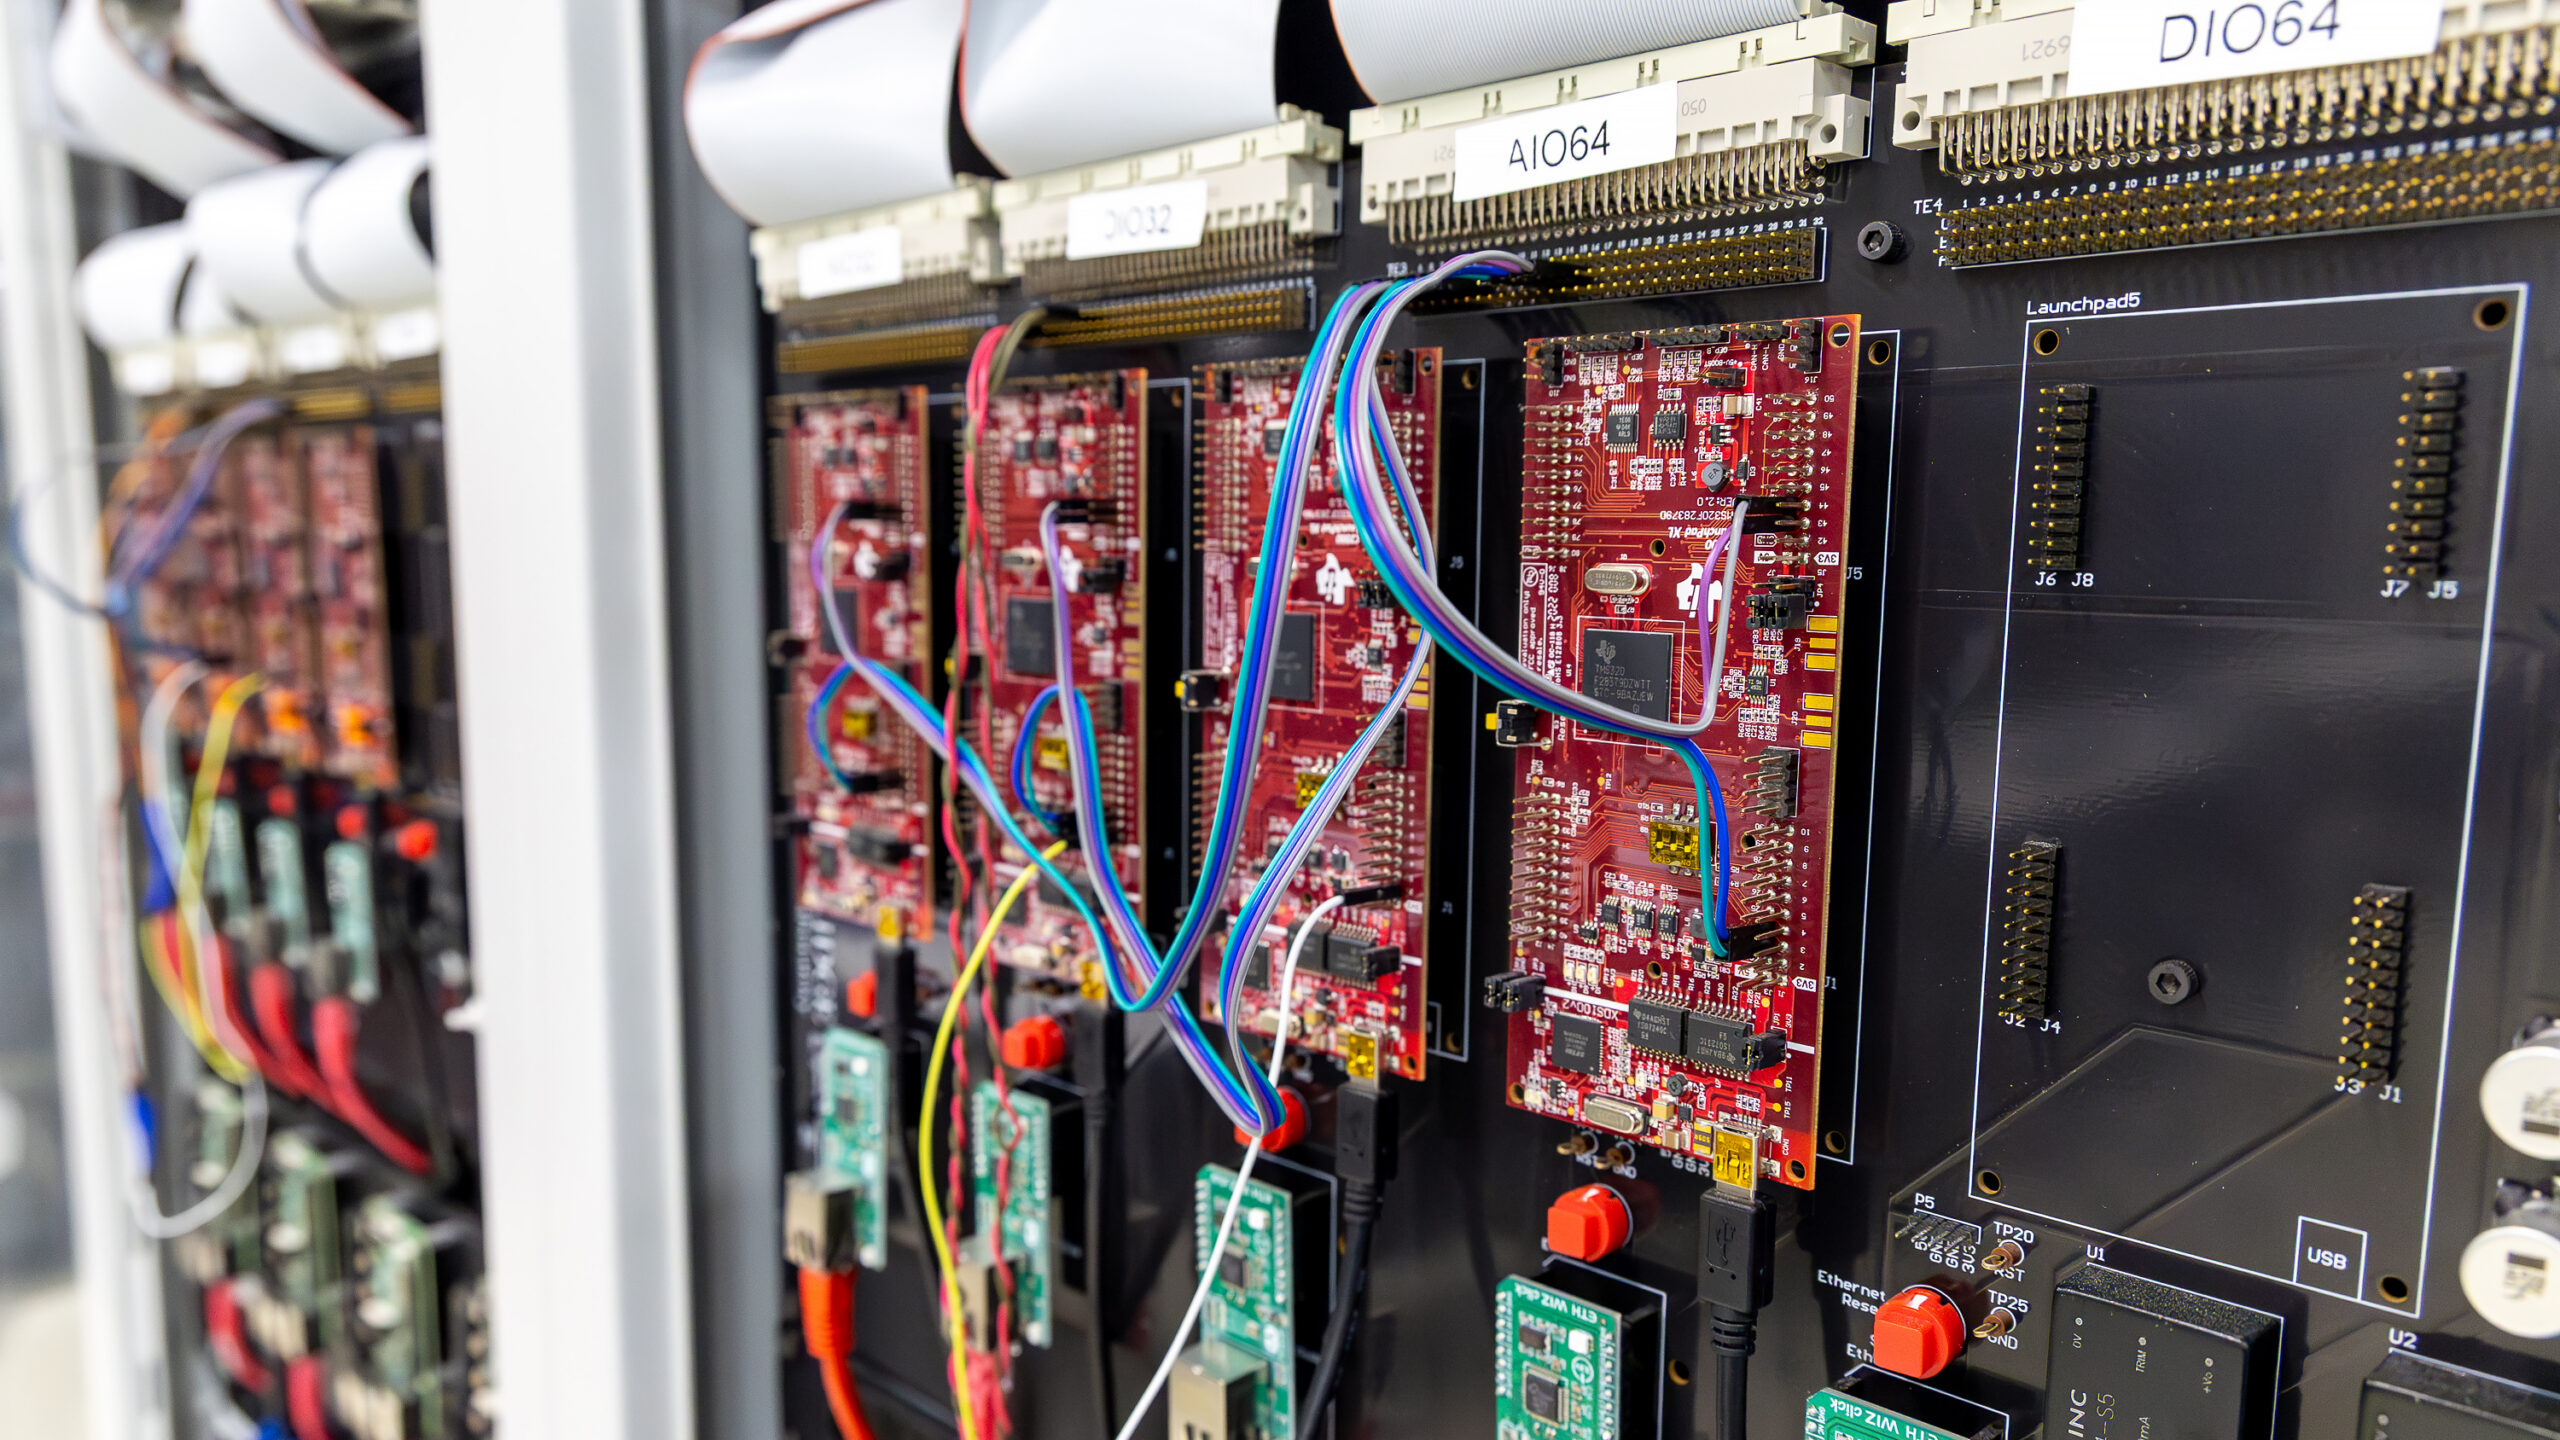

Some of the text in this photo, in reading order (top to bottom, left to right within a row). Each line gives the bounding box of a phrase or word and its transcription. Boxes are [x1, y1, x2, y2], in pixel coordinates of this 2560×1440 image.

[2161, 0, 2340, 63] DIO64
[1509, 119, 1611, 172] AIO64
[1962, 200, 1968, 208] 1
[1979, 197, 1987, 206] 2
[1997, 195, 2005, 204] 3
[2015, 193, 2022, 202] 4
[2051, 188, 2060, 197] 6
[2069, 186, 2078, 195] 7
[2125, 179, 2138, 188] 10
[2147, 176, 2158, 186] 11
[2166, 173, 2180, 184] 12
[2186, 171, 2200, 182] 13
[2206, 168, 2220, 179] 14
[1914, 198, 1943, 215] TE4
[1739, 225, 1749, 234] 27
[1783, 220, 1793, 229] 30
[1798, 218, 1808, 227] 31
[1813, 216, 1824, 226] 32
[2027, 291, 2141, 314] Launchpad5
[1762, 344, 1770, 371] CAN-L
[1804, 376, 1818, 384] J16
[1823, 412, 1834, 420] 49
[1822, 431, 1832, 439] 48
[1820, 466, 1831, 474] 46
[1819, 482, 1830, 491] 45
[1697, 497, 1714, 507] 2.0
[1660, 510, 1734, 520] MS320F28379D
[1668, 527, 1682, 538] XL
[1818, 553, 1837, 562] 3V3
[1846, 567, 1863, 580] J5
[2035, 571, 2094, 588] J6 J8
[2380, 579, 2459, 600] J7 J5
[1547, 596, 1559, 622] 2022
[1595, 663, 1625, 676] TMS320
[1763, 988, 1773, 996] J3
[1796, 979, 1814, 989] 3V3
[1824, 976, 1837, 990] J1
[1562, 999, 1619, 1020] XDS100v2
[2040, 1020, 2062, 1035] J4
[2379, 1084, 2402, 1104] J1
[1914, 1192, 1935, 1209] P5
[1993, 1220, 2035, 1244] TP20
[1962, 1245, 1976, 1274] 3V3
[2086, 1244, 2105, 1262] U1
[2307, 1246, 2347, 1271] USB
[1817, 1269, 1886, 1302] Ethernet
[1541, 1293, 1569, 1313] WIZ
[1841, 1292, 1878, 1315] Rese
[1987, 1289, 2029, 1313] TP25
[1571, 1303, 1598, 1324] ETH
[1986, 1333, 2019, 1350] GND
[2388, 1327, 2418, 1350] U2
[2135, 1350, 2148, 1373] TRIM
[1829, 1396, 1863, 1419] click
[2068, 1389, 2088, 1438] INC
[1865, 1410, 1900, 1435] WIZ
[2136, 1416, 2151, 1440] mA
